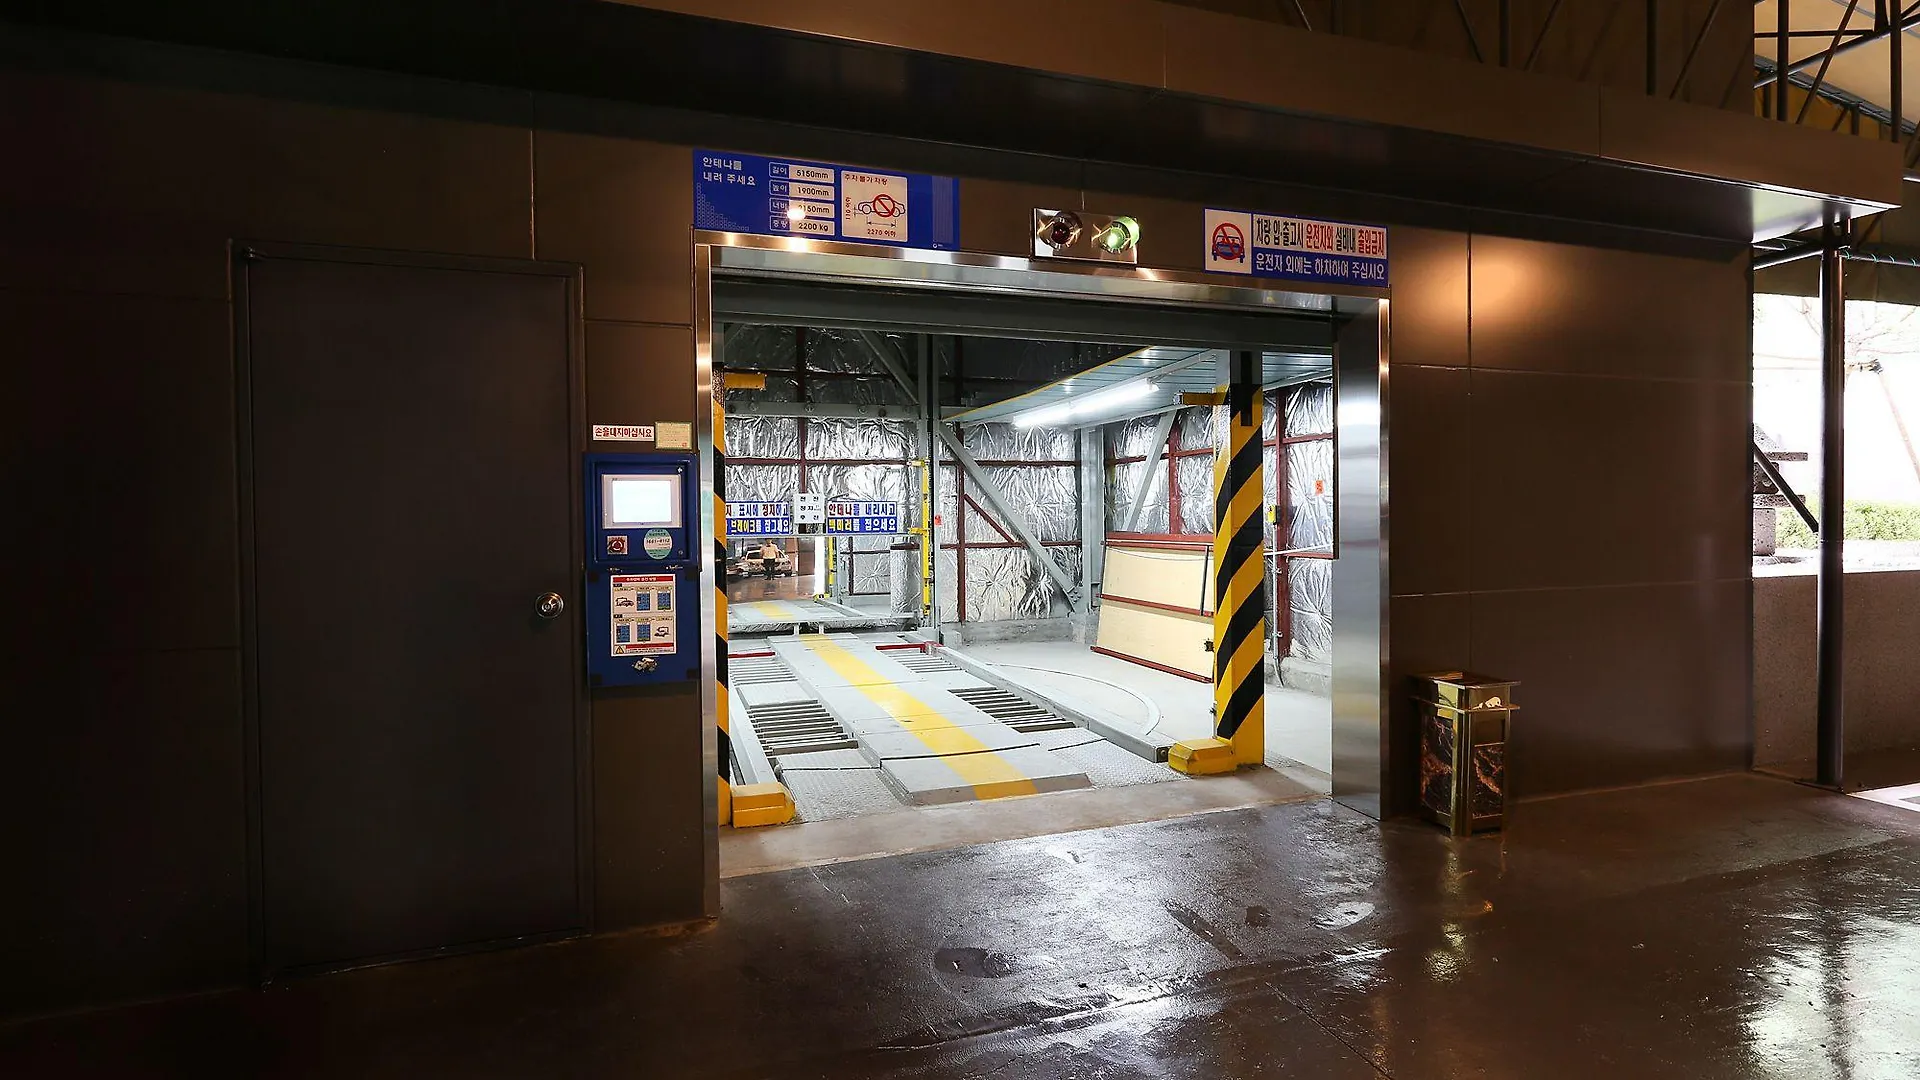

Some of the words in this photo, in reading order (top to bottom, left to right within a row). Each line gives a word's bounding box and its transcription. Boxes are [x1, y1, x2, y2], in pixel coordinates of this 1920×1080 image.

[702, 156, 742, 171] 안테나를
[703, 172, 722, 183] 내려
[727, 174, 756, 186] 주세요
[772, 166, 787, 175] 길이
[796, 169, 829, 179] 5150mm
[772, 183, 787, 193] 높이
[797, 186, 830, 196] 1900mm
[798, 222, 817, 230] 2200
[819, 223, 829, 232] kg
[867, 228, 883, 236] 2270
[1256, 218, 1271, 245] 차량
[1336, 226, 1356, 253] 설비내
[1357, 228, 1384, 256] 출입금지
[1255, 252, 1283, 272] 운전자
[1286, 255, 1312, 274] 외에는
[1315, 257, 1349, 278] 하차하여
[1351, 261, 1385, 280] 주십시오
[739, 503, 758, 517] 표시에
[763, 503, 789, 517] 정지하고
[828, 503, 860, 516] 안테나를
[865, 503, 896, 516] 내리시고
[731, 519, 762, 533] 브레이크를
[765, 519, 789, 533] 잠그세요
[828, 518, 860, 532] 백미러를
[865, 518, 896, 532] 접으세요
